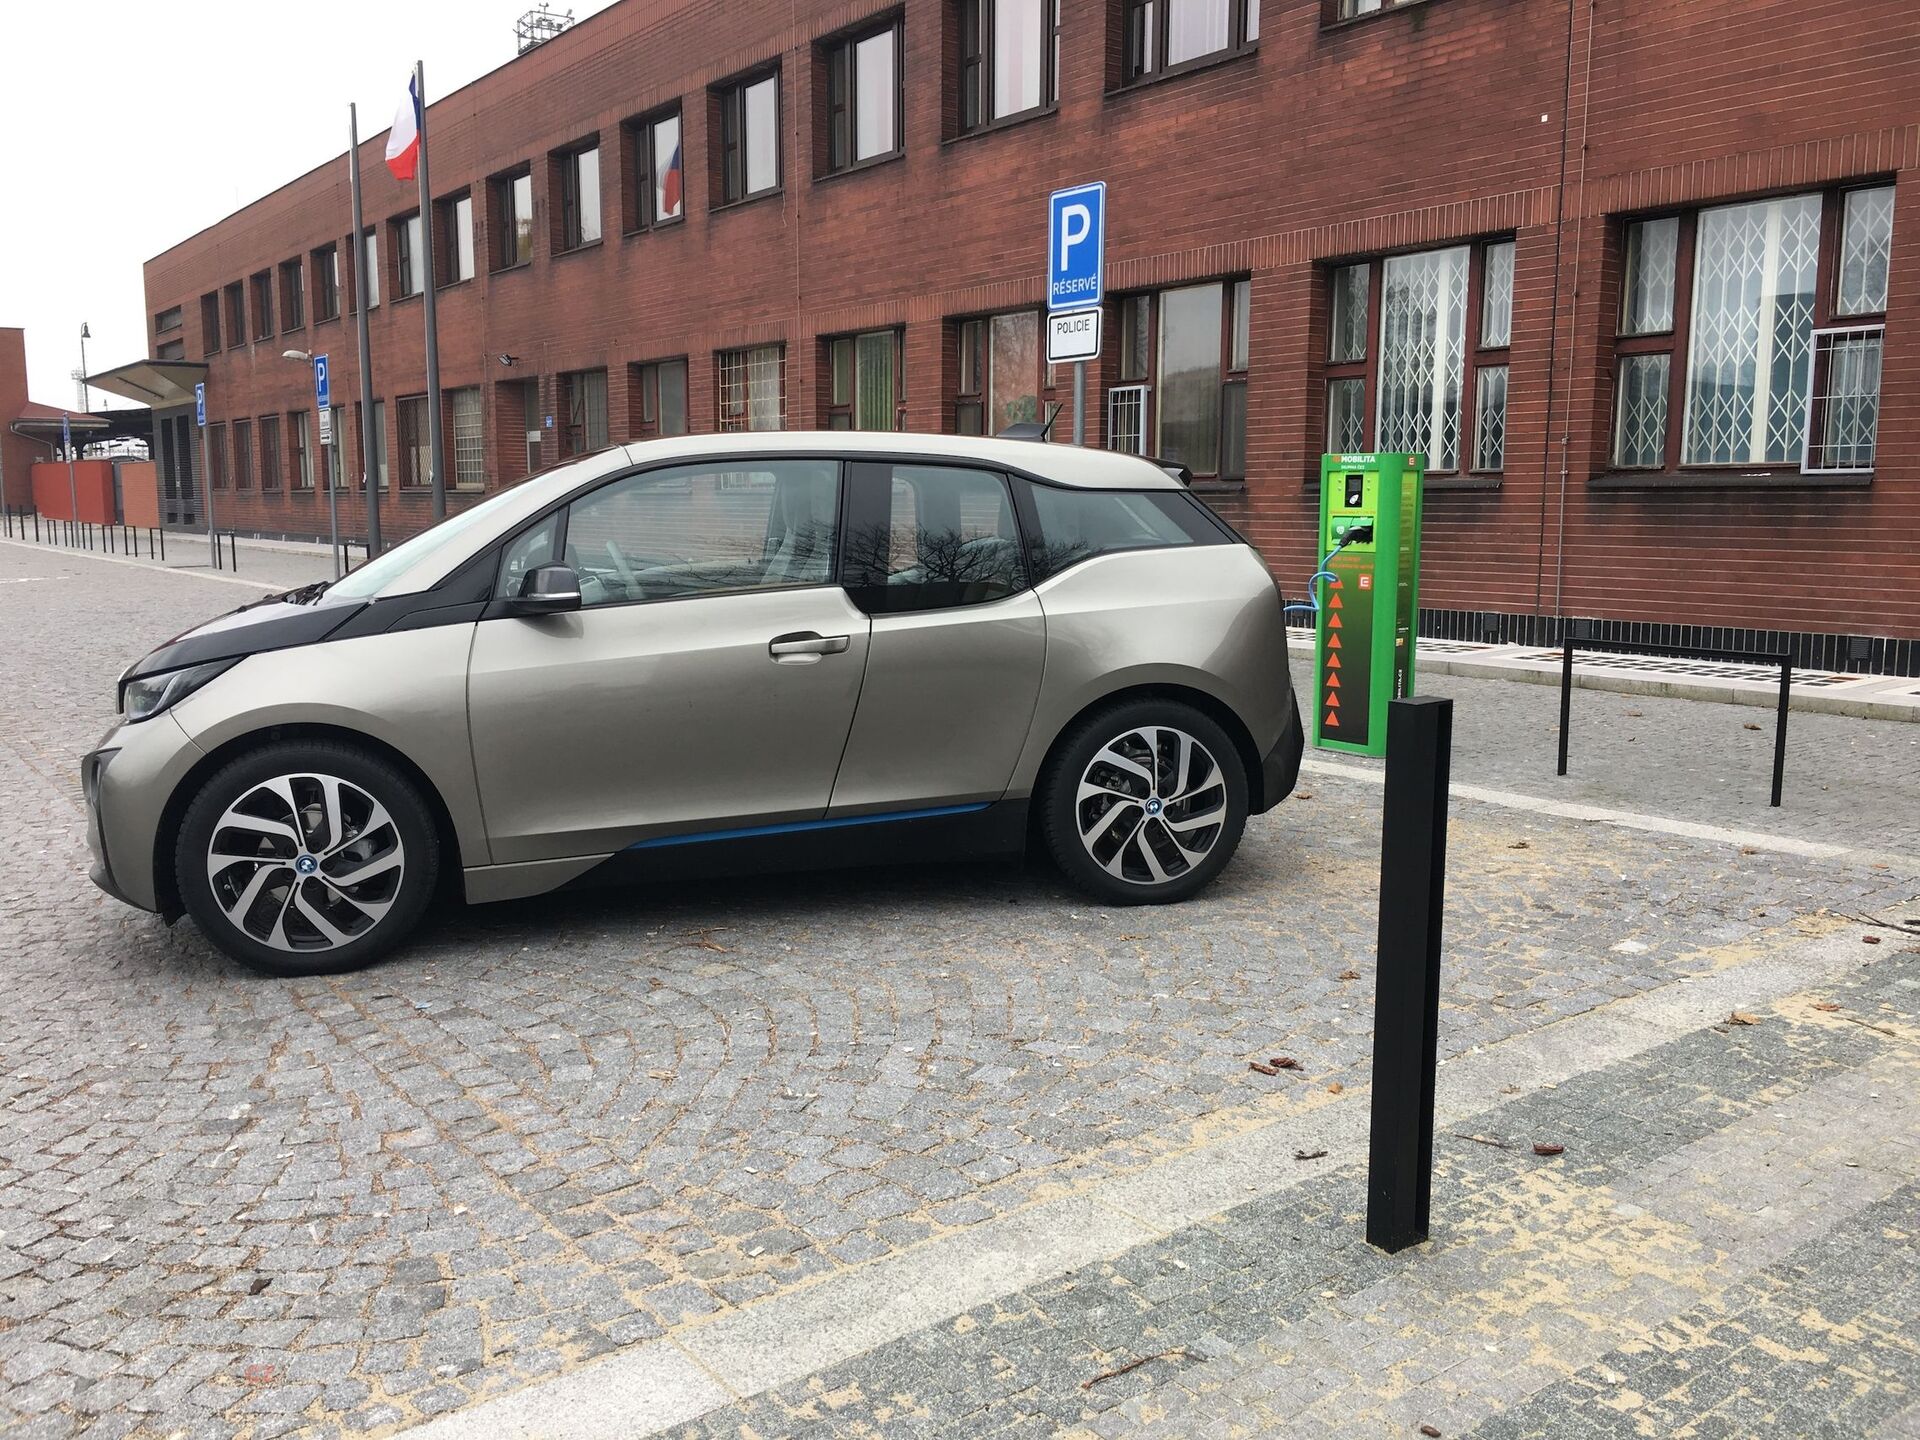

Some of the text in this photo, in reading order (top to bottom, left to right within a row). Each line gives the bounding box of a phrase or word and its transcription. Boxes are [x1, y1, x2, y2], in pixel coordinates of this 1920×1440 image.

[1061, 203, 1091, 272] P
[1053, 273, 1096, 295] RÉSERVÉ
[1057, 318, 1090, 334] POLICIE
[317, 362, 325, 392] P
[1341, 455, 1375, 463] MOBILITA
